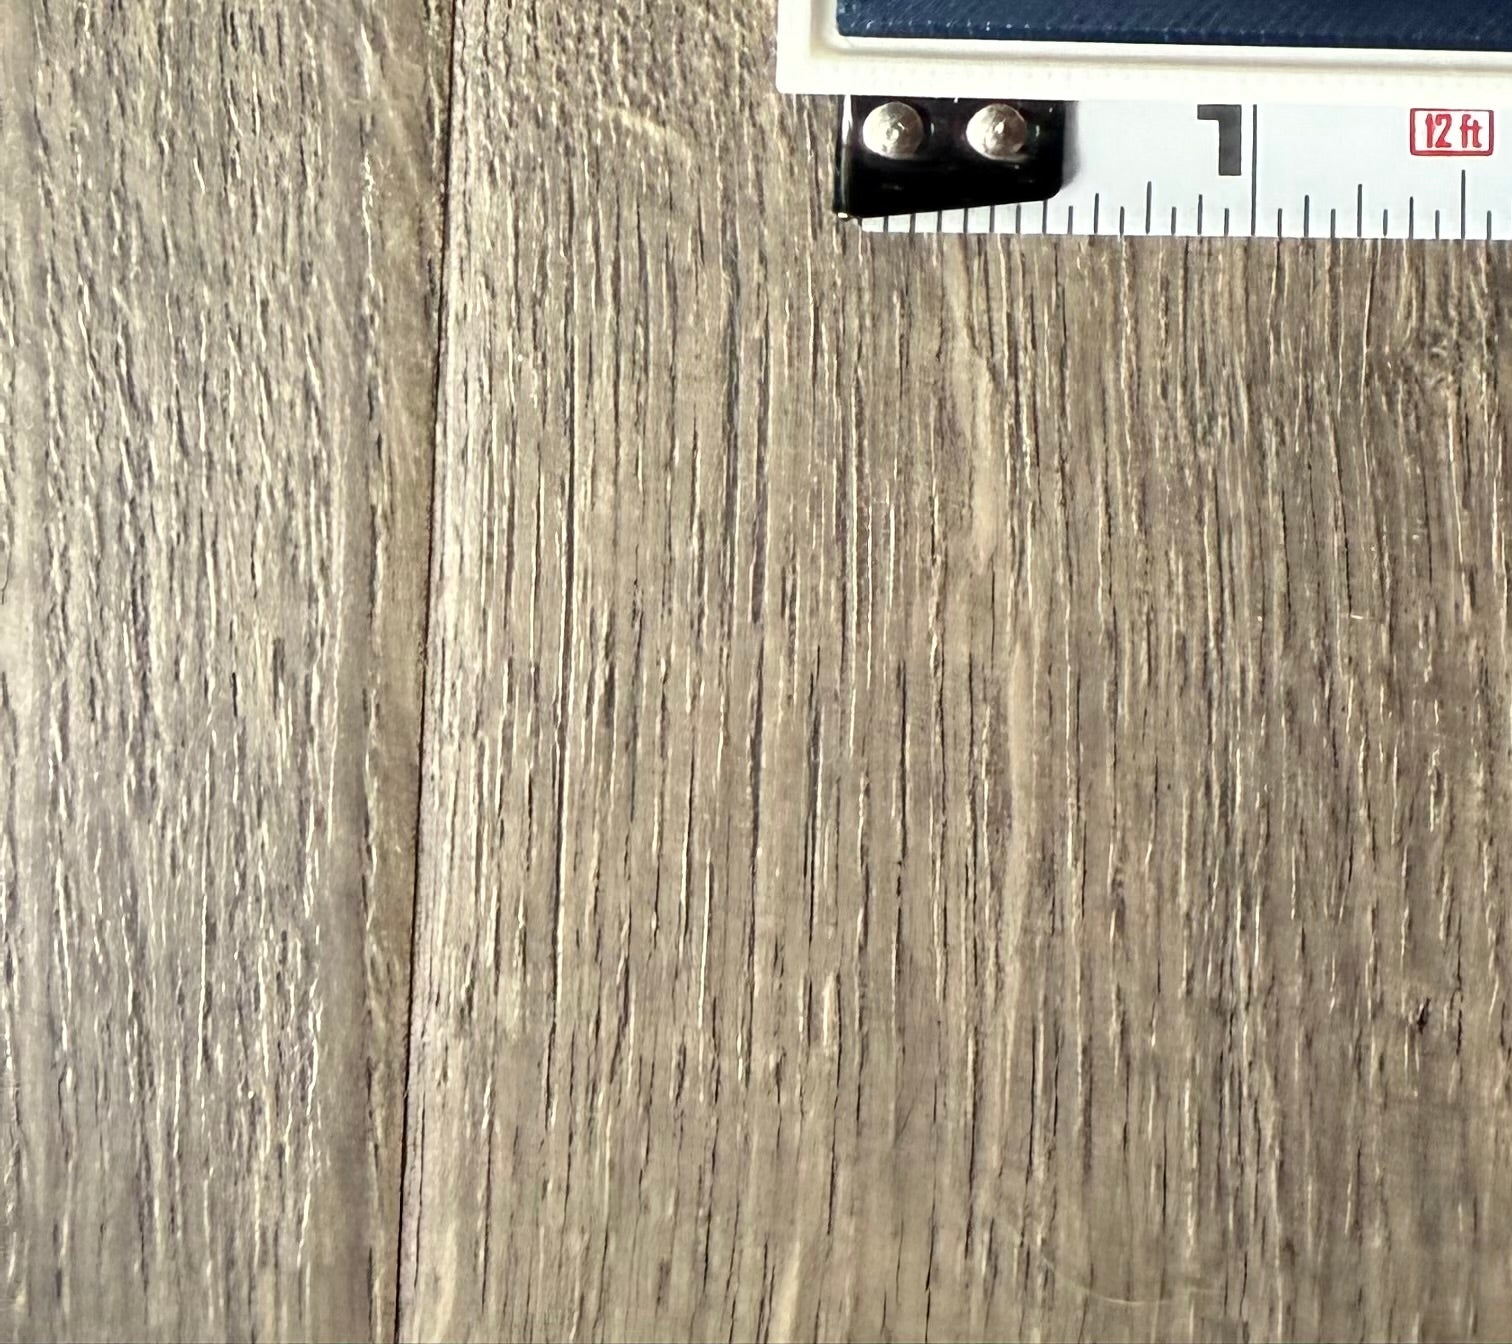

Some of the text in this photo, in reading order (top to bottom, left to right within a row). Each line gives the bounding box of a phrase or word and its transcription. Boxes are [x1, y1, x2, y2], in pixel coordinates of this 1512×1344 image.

[1197, 104, 1242, 176] 1
[1424, 114, 1482, 148] 12 ft
